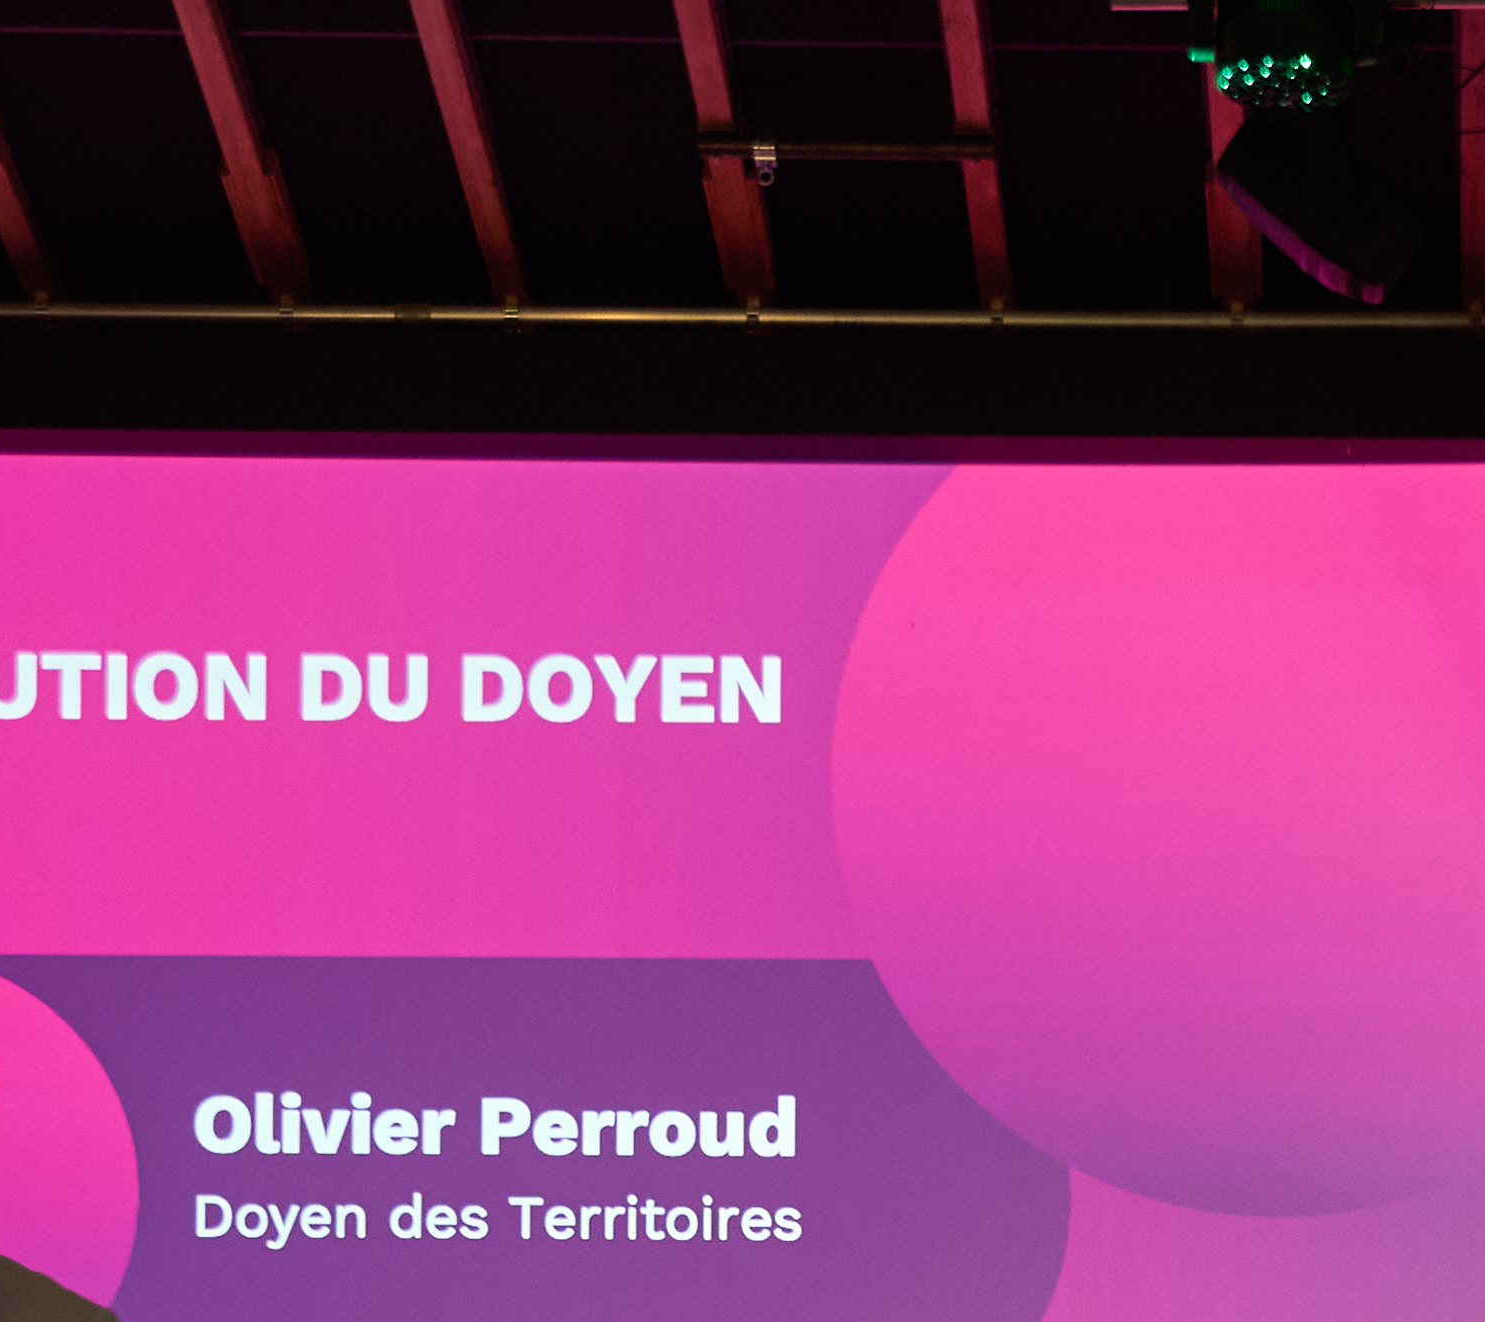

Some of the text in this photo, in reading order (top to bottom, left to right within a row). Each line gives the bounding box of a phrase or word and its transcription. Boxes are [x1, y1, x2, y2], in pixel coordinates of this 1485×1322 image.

[300, 653, 428, 722] DU
[461, 653, 782, 723] DOYEN
[192, 1091, 796, 1158] Olivier Perroud
[194, 1191, 804, 1249] Doyen des Territoires
